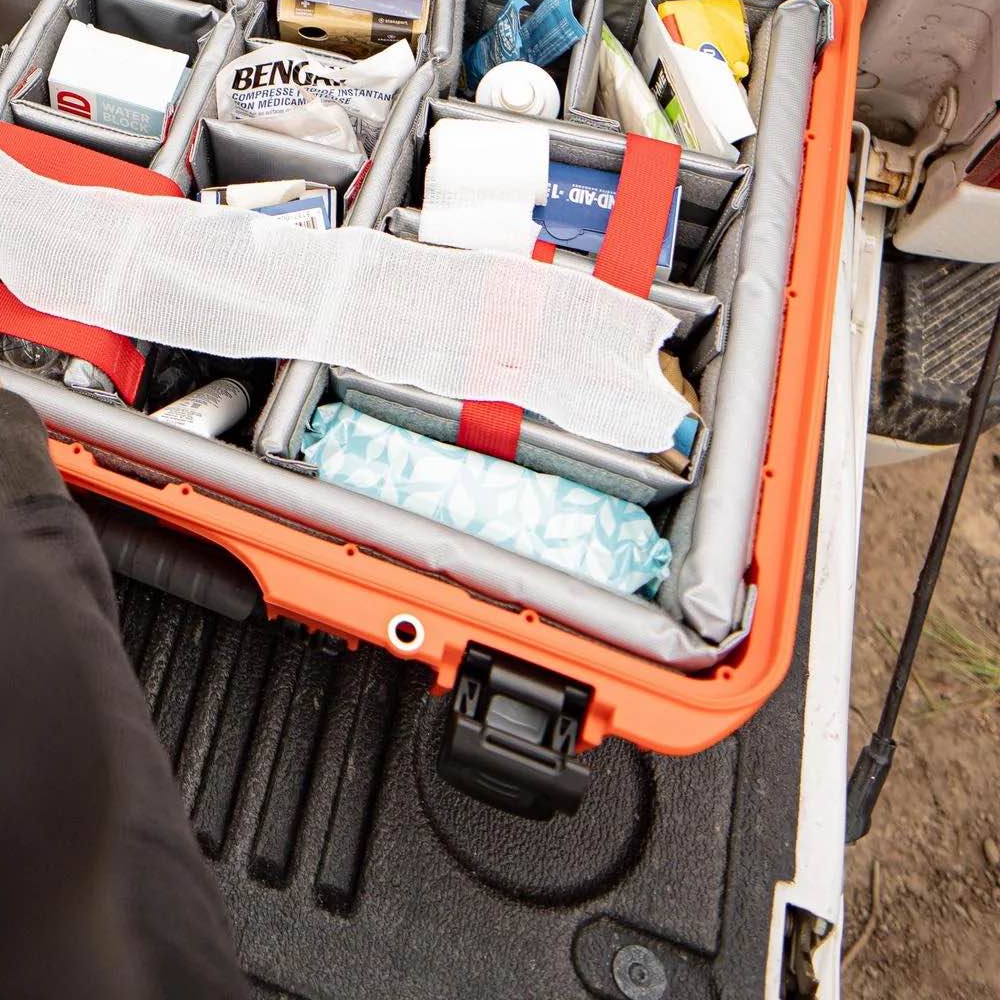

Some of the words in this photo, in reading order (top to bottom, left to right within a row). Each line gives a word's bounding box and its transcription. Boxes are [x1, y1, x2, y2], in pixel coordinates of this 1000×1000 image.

[232, 59, 346, 91] BENGA
[232, 87, 295, 102] COMPRESSE
[338, 88, 394, 101] INSTANTAN
[102, 103, 150, 124] WATER
[102, 111, 149, 134] BLOCK
[568, 187, 616, 210] ND-AID
